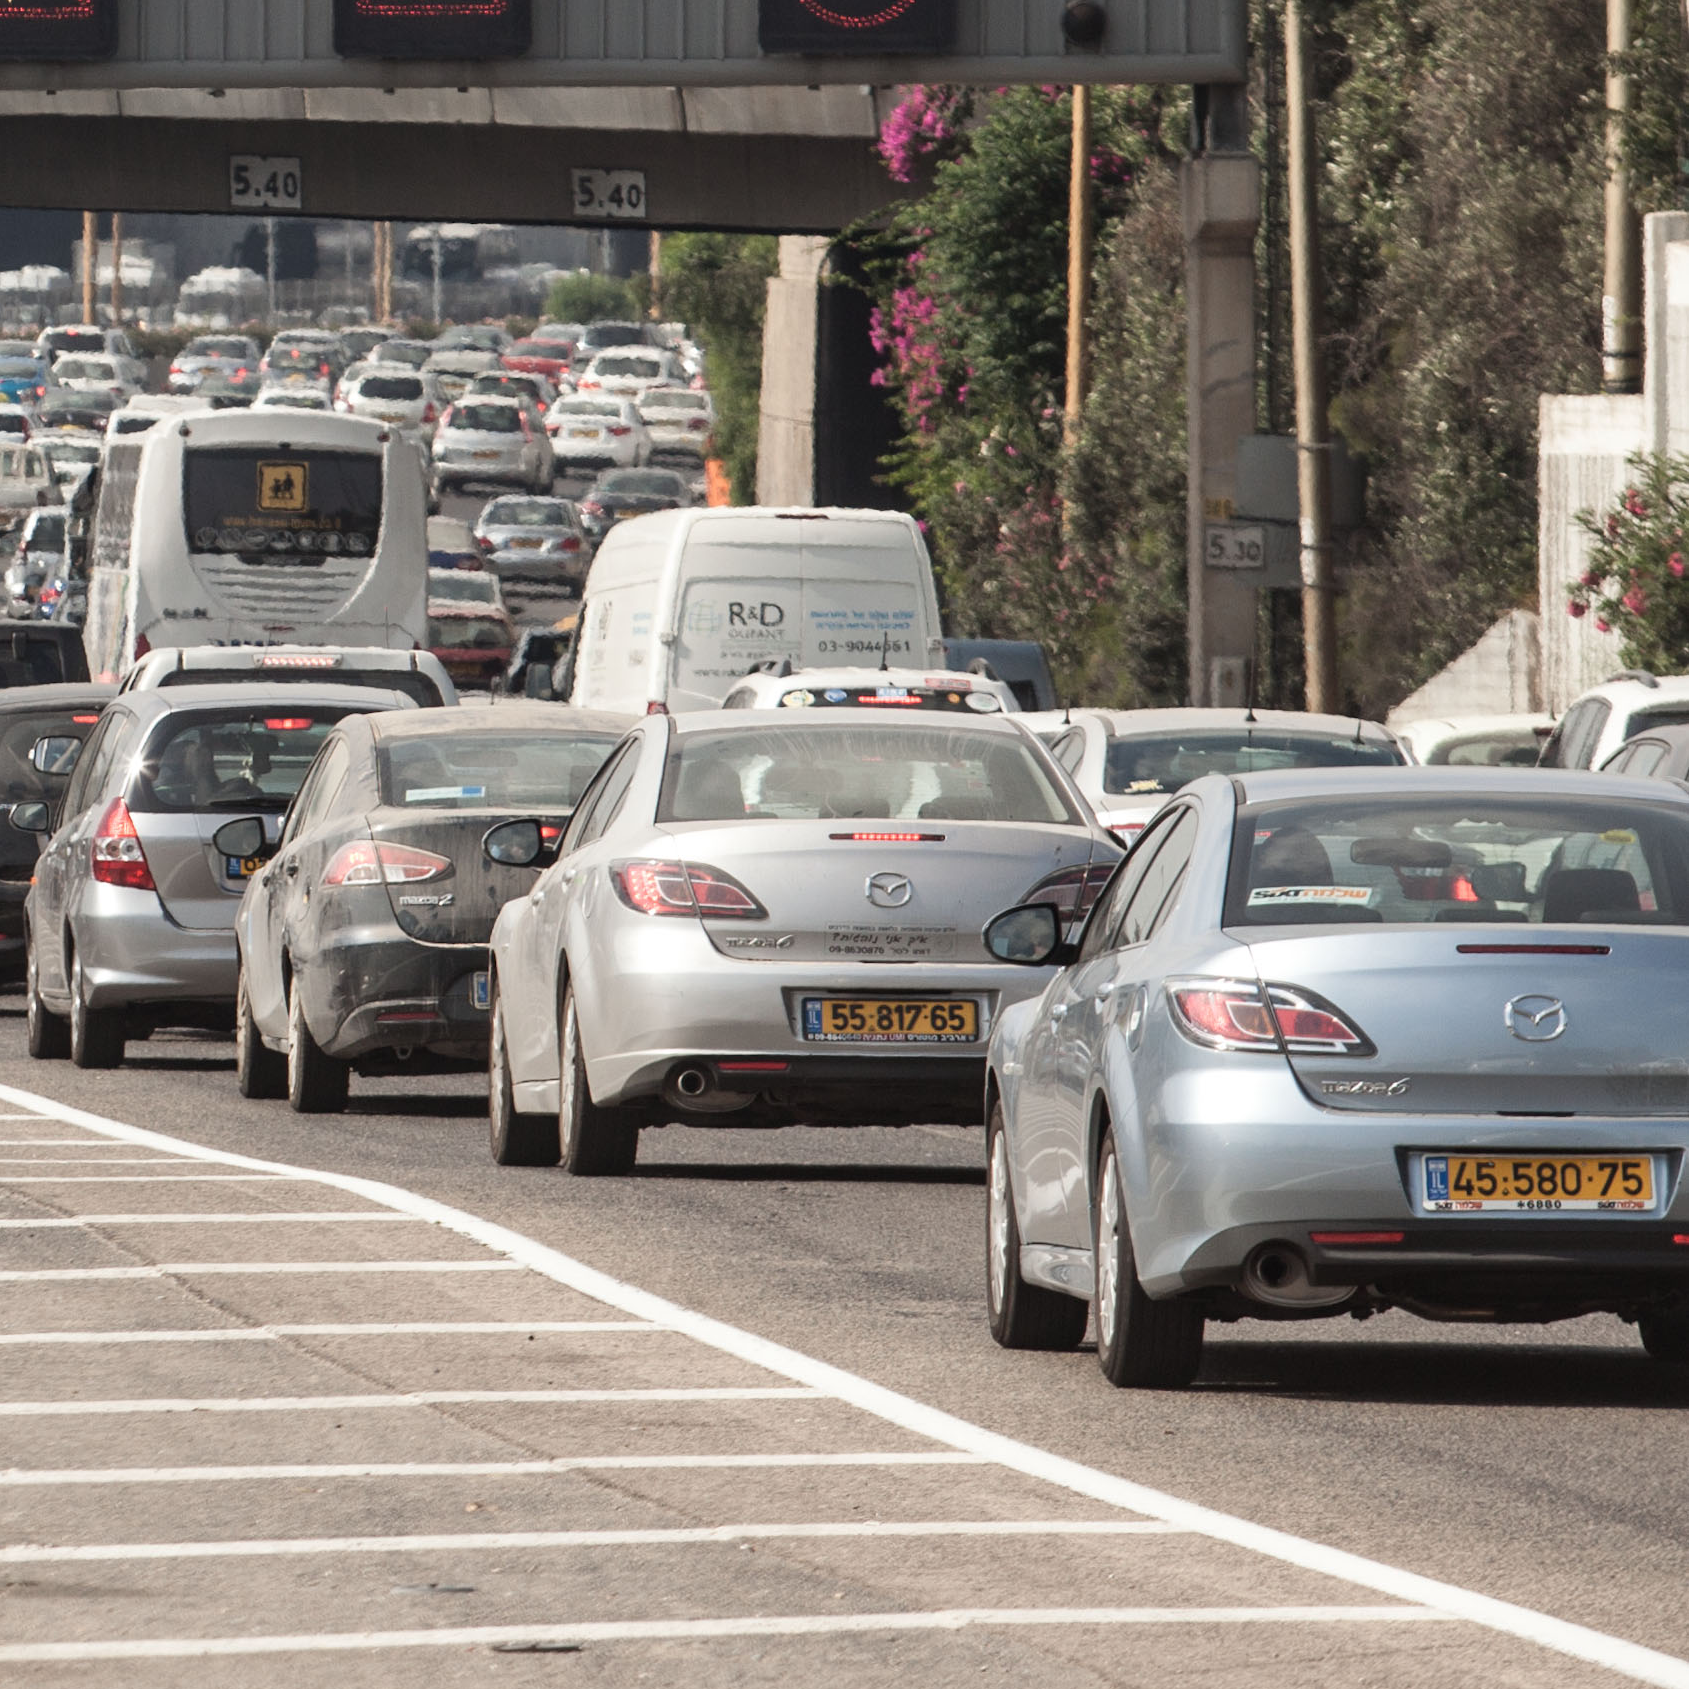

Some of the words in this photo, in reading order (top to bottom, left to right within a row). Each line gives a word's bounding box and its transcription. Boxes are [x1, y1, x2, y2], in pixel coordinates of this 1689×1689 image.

[234, 165, 299, 198] 5.40
[578, 176, 644, 210] 5.40
[729, 602, 785, 627] R&D
